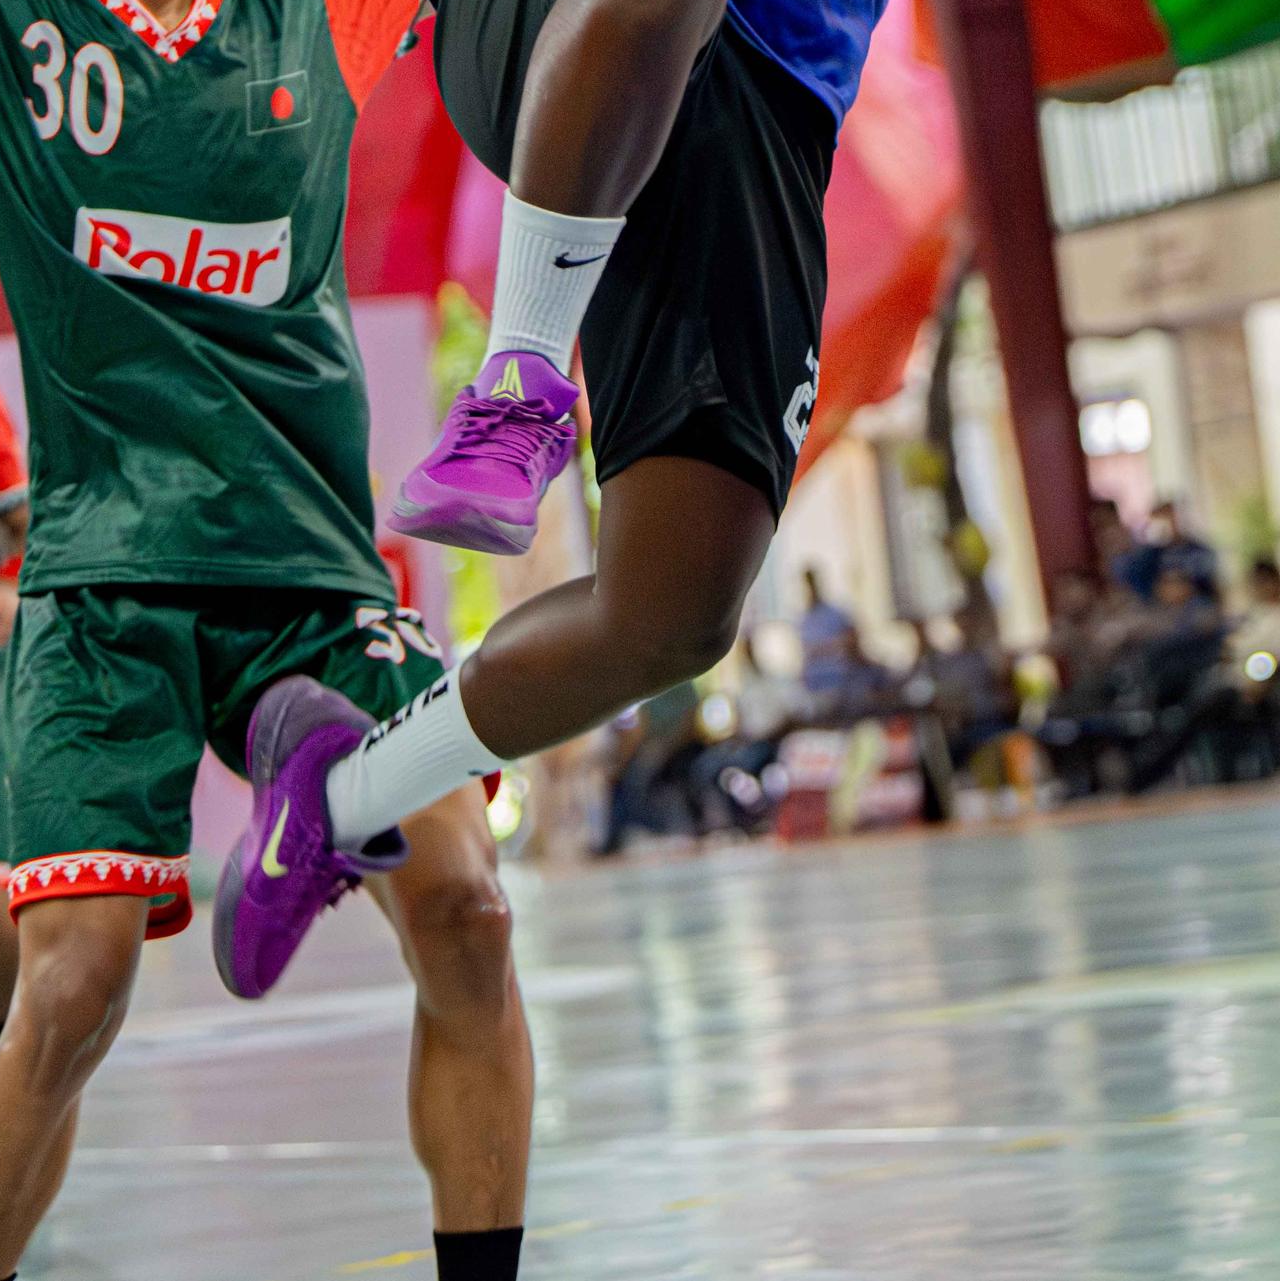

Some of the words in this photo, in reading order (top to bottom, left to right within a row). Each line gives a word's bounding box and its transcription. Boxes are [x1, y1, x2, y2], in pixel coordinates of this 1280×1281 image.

[21, 19, 124, 155] 30
[87, 217, 281, 295] Polar
[355, 606, 443, 665] 30
